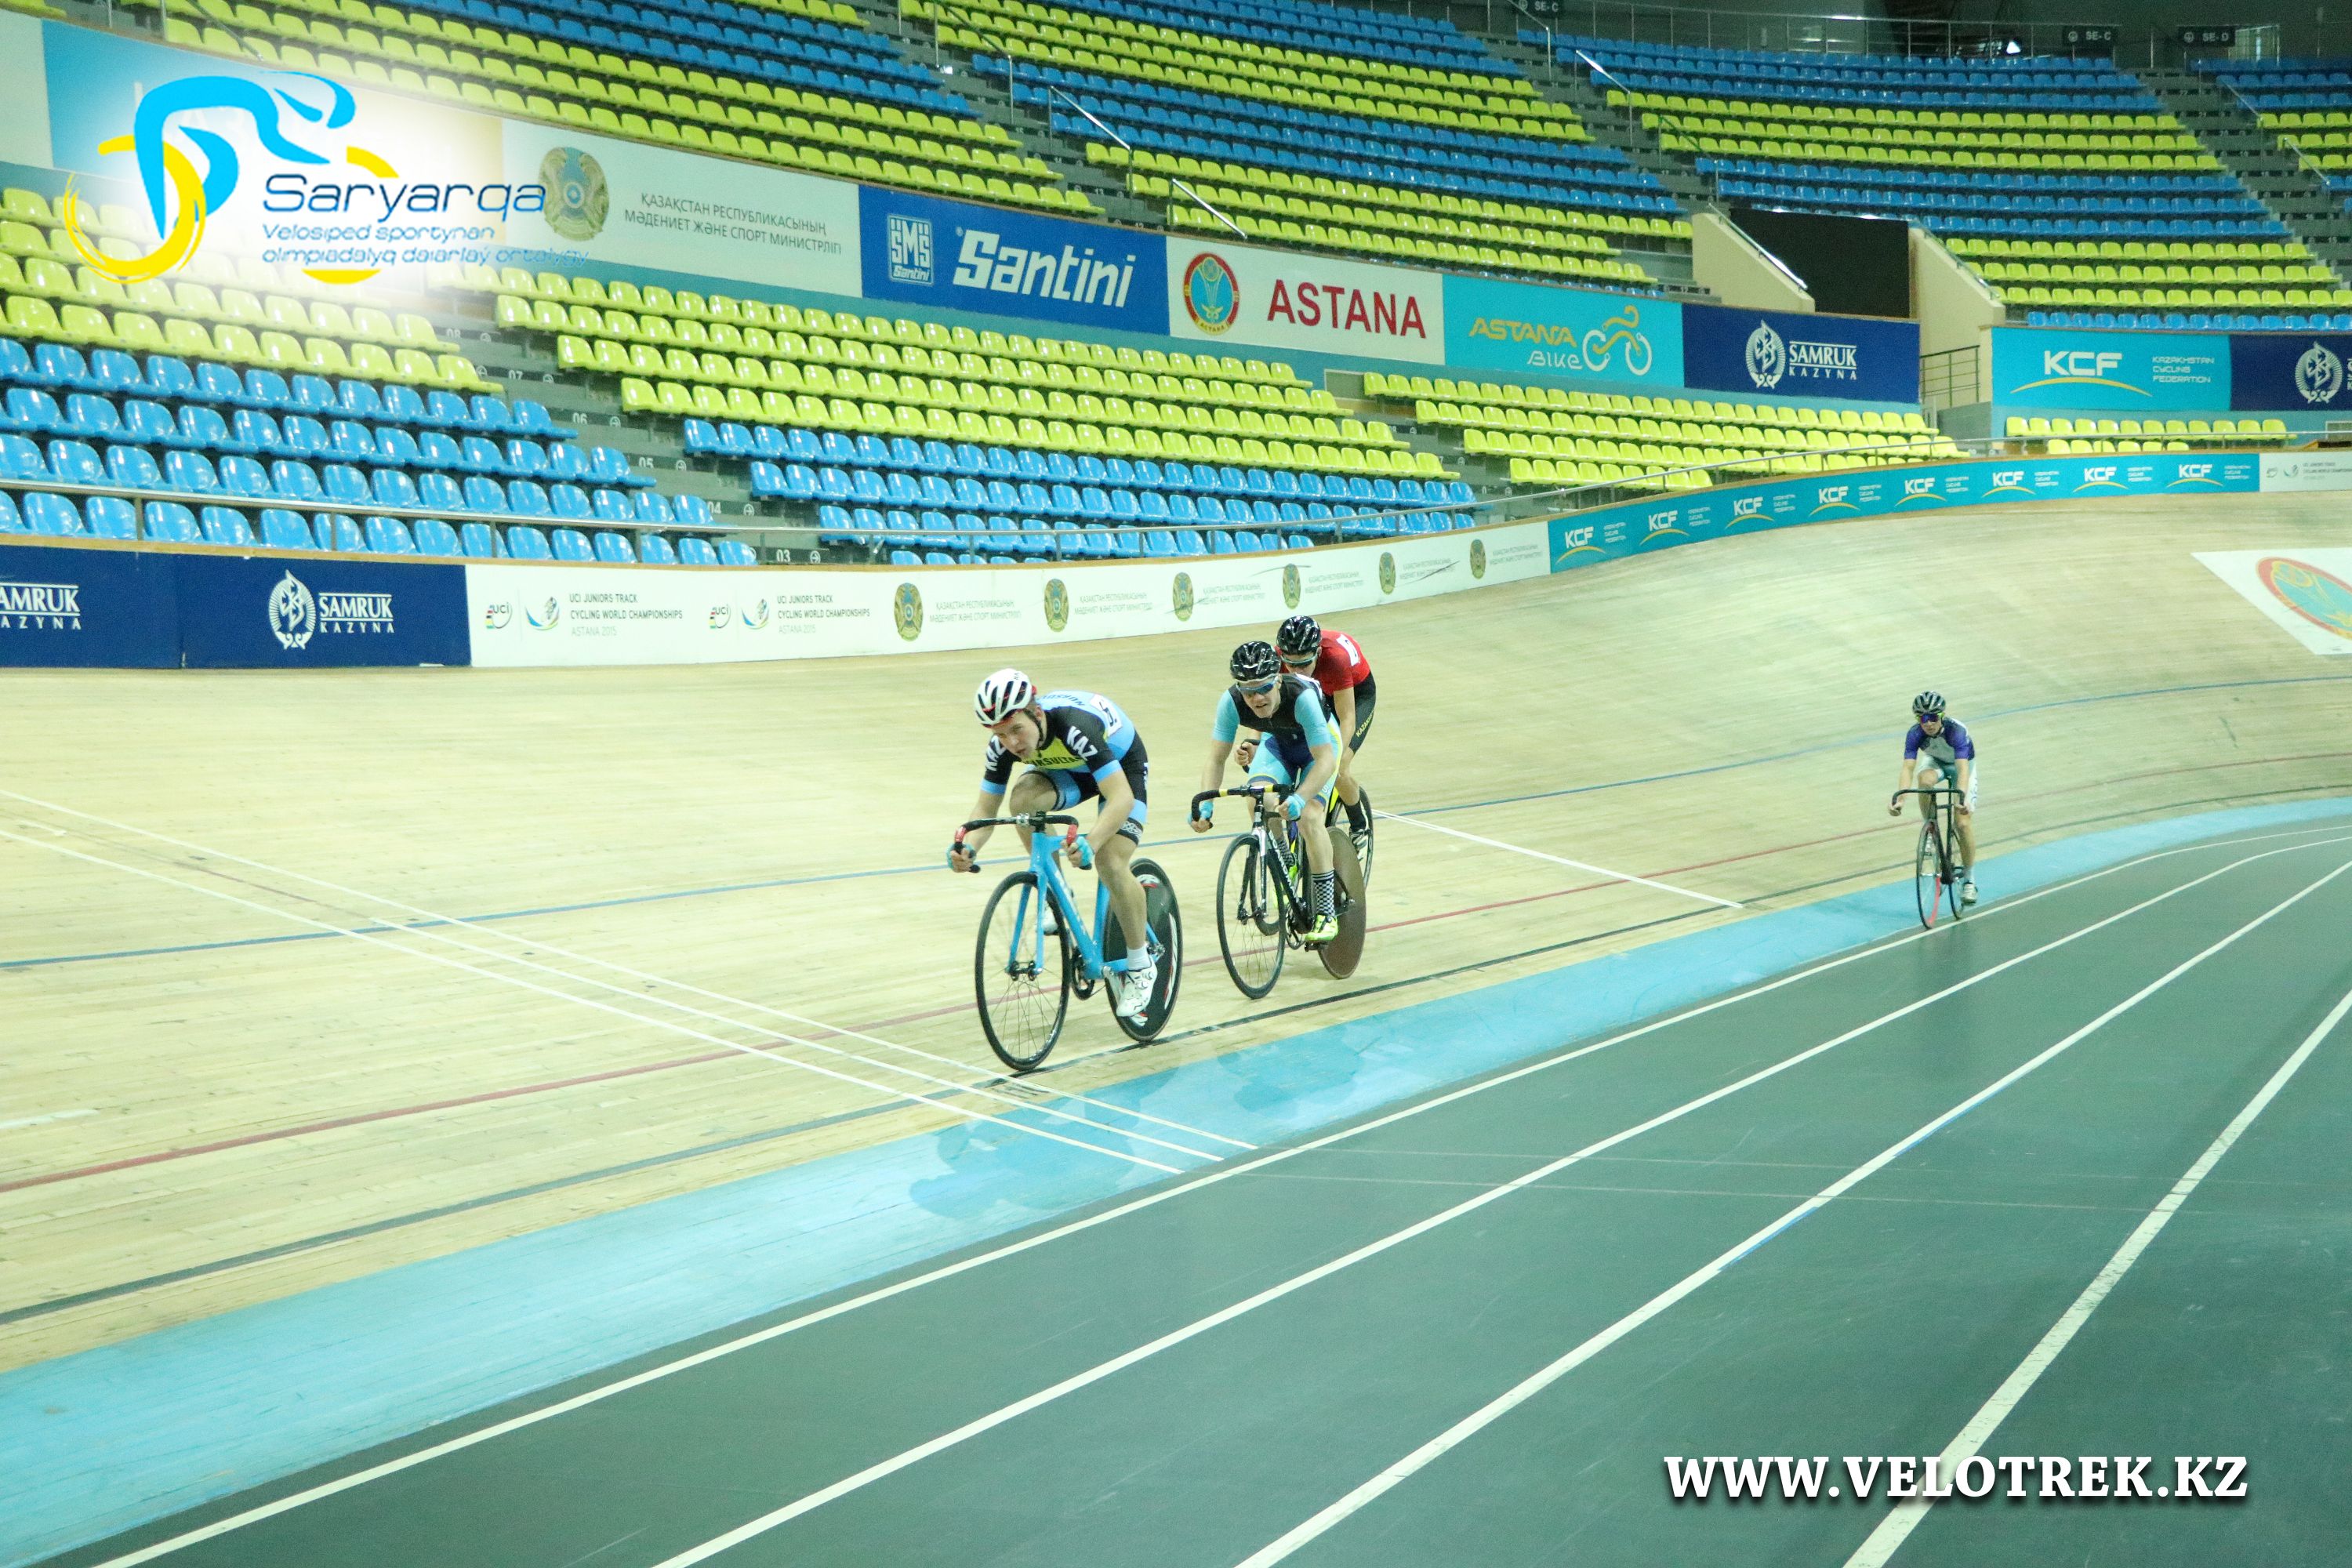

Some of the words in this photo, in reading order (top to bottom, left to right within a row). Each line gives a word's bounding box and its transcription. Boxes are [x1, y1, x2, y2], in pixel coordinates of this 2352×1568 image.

[692, 220, 728, 238] ЖӘНЕ
[731, 226, 768, 244] СПОРТ
[890, 219, 931, 268] SMS
[953, 229, 1136, 307] Santini
[1267, 278, 1427, 339] ASTANA
[1468, 318, 1577, 348] ASTANA
[1789, 344, 1857, 366] SAMRUK
[2044, 350, 2122, 376] KCF
[1789, 366, 1857, 380] KAZYNA
[638, 457, 654, 470] 05
[2179, 464, 2212, 478] KCF
[1992, 471, 2024, 486] KCF
[2084, 466, 2117, 481] KCF
[1905, 477, 1935, 494] KCF
[1819, 487, 1849, 503] KCF
[1733, 497, 1763, 515] KCF
[1648, 510, 1678, 531] KCF
[1565, 527, 1594, 548] KCF
[775, 549, 791, 563] 03
[0, 586, 80, 612] AMRUK
[569, 593, 581, 603] UCI
[583, 593, 613, 603] JUNIORS
[615, 593, 638, 603] TRACK
[789, 595, 813, 604] JUNIORS
[815, 594, 833, 603] TRACK
[319, 596, 393, 618] SAMRUK
[570, 610, 601, 619] CYCLING
[602, 610, 627, 619] WORLD
[628, 610, 683, 619] CHAMPIONSHIPS
[778, 610, 803, 619] CYCLING
[826, 608, 870, 618] CHAMPIONSHIPS
[1, 615, 82, 630] AZYNA
[320, 622, 394, 633] KAZYNA
[1067, 726, 1098, 761] KAZ
